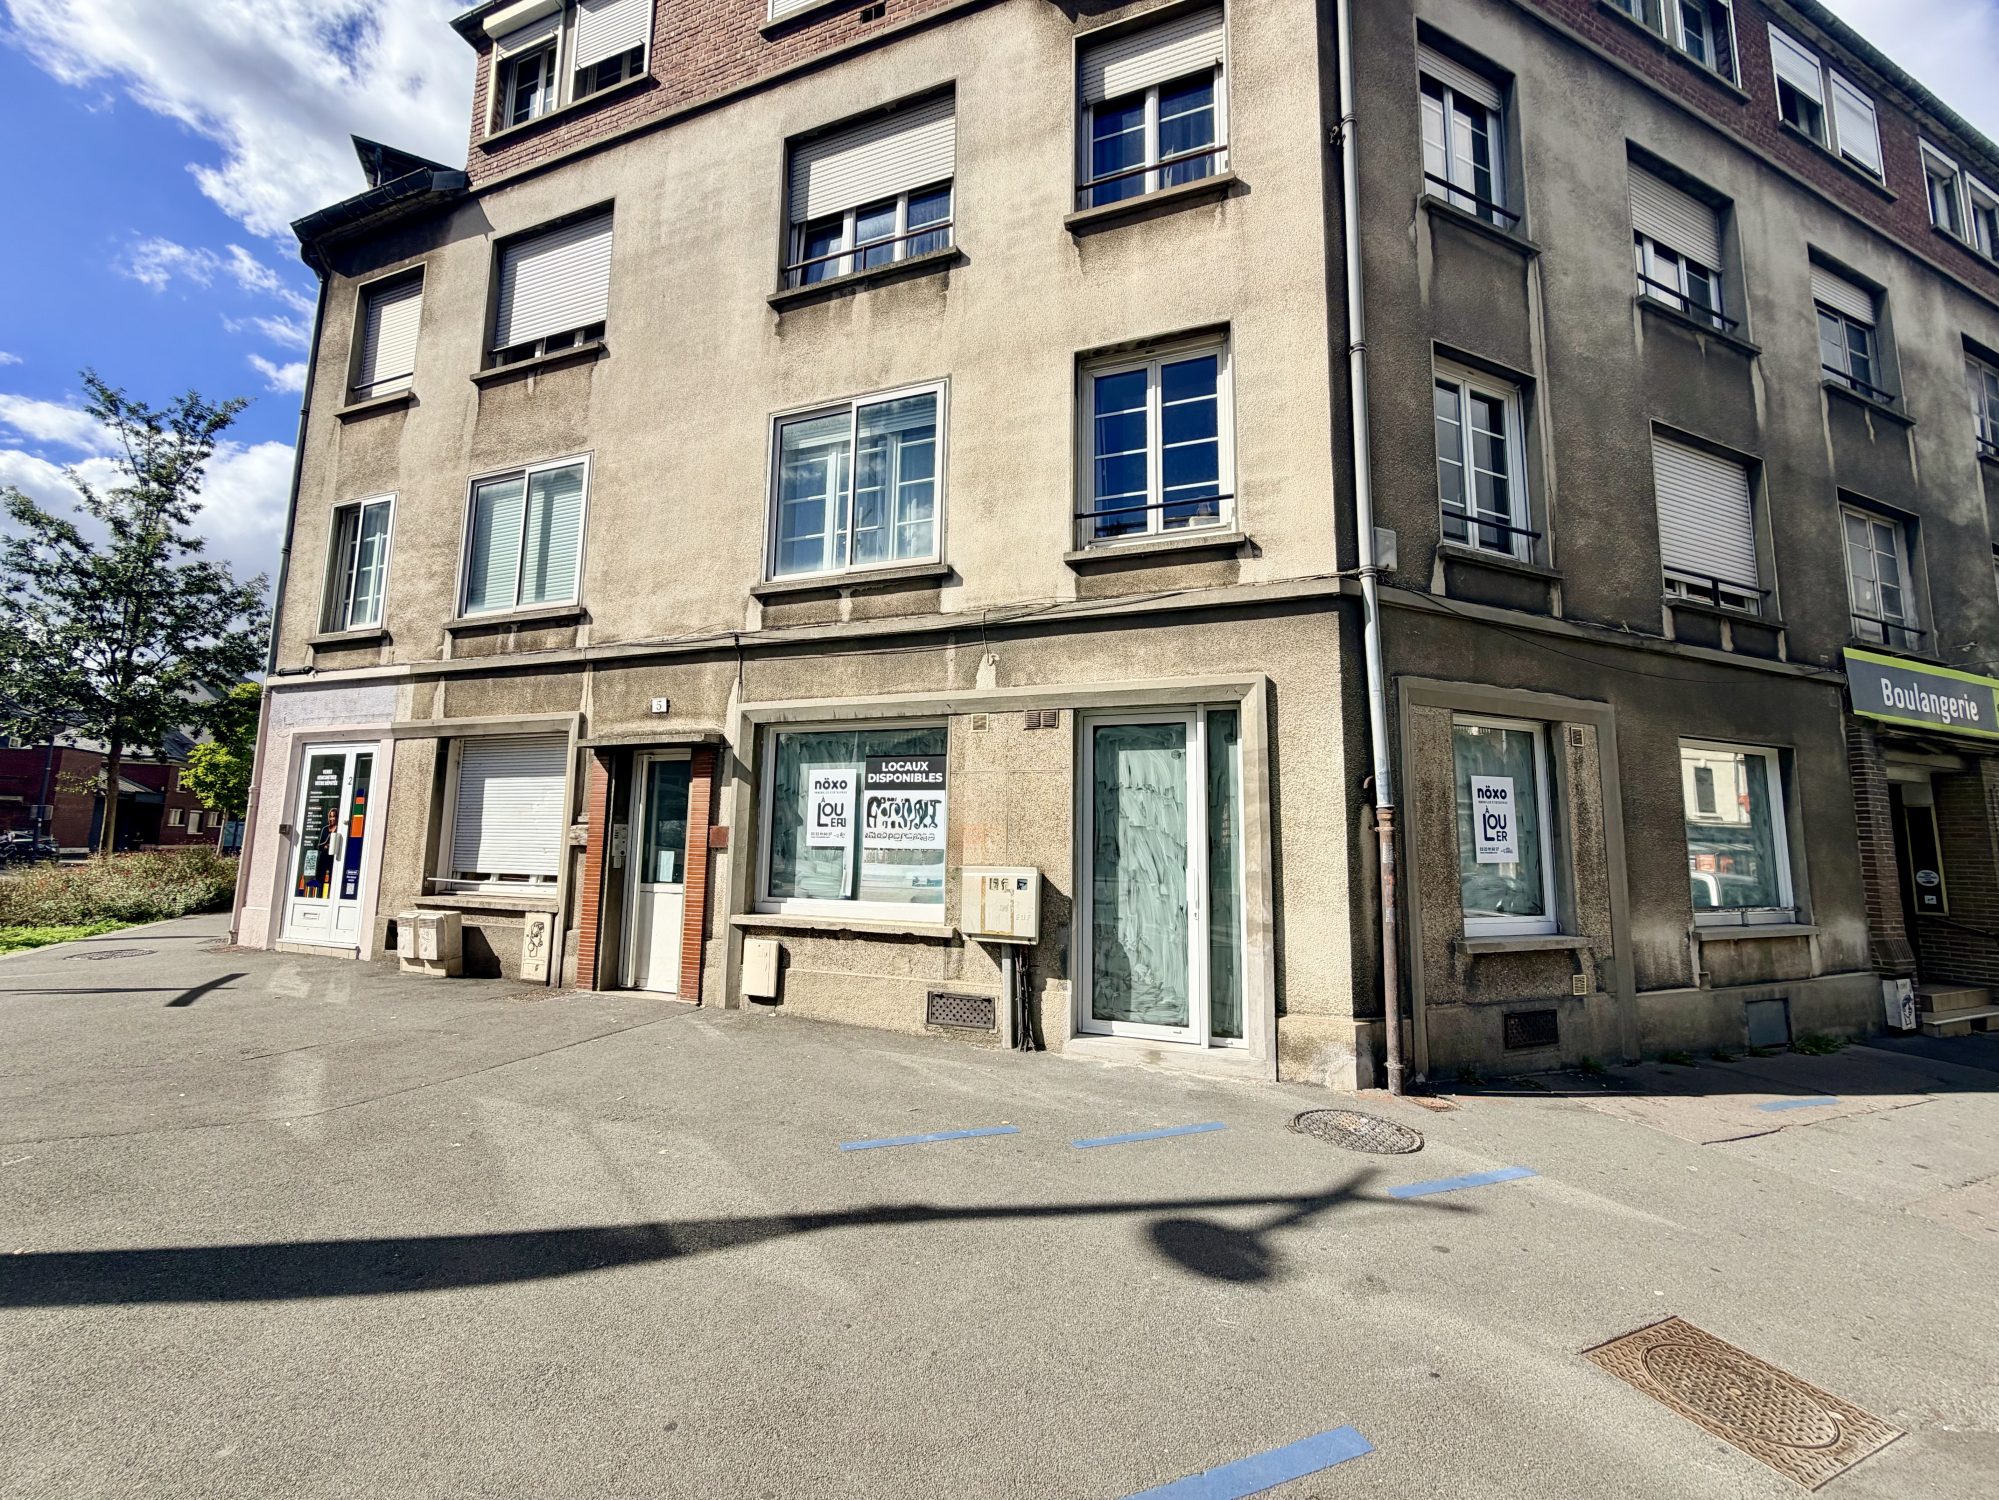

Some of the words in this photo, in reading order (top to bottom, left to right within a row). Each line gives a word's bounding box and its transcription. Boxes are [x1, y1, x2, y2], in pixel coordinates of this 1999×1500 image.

[1880, 677, 1980, 724] Boulangerie
[881, 761, 929, 772] LOCAUX
[347, 776, 353, 786] 2
[814, 777, 848, 790] nöxo
[867, 772, 943, 783] DISPONIBLES
[1477, 785, 1507, 800] nöxo
